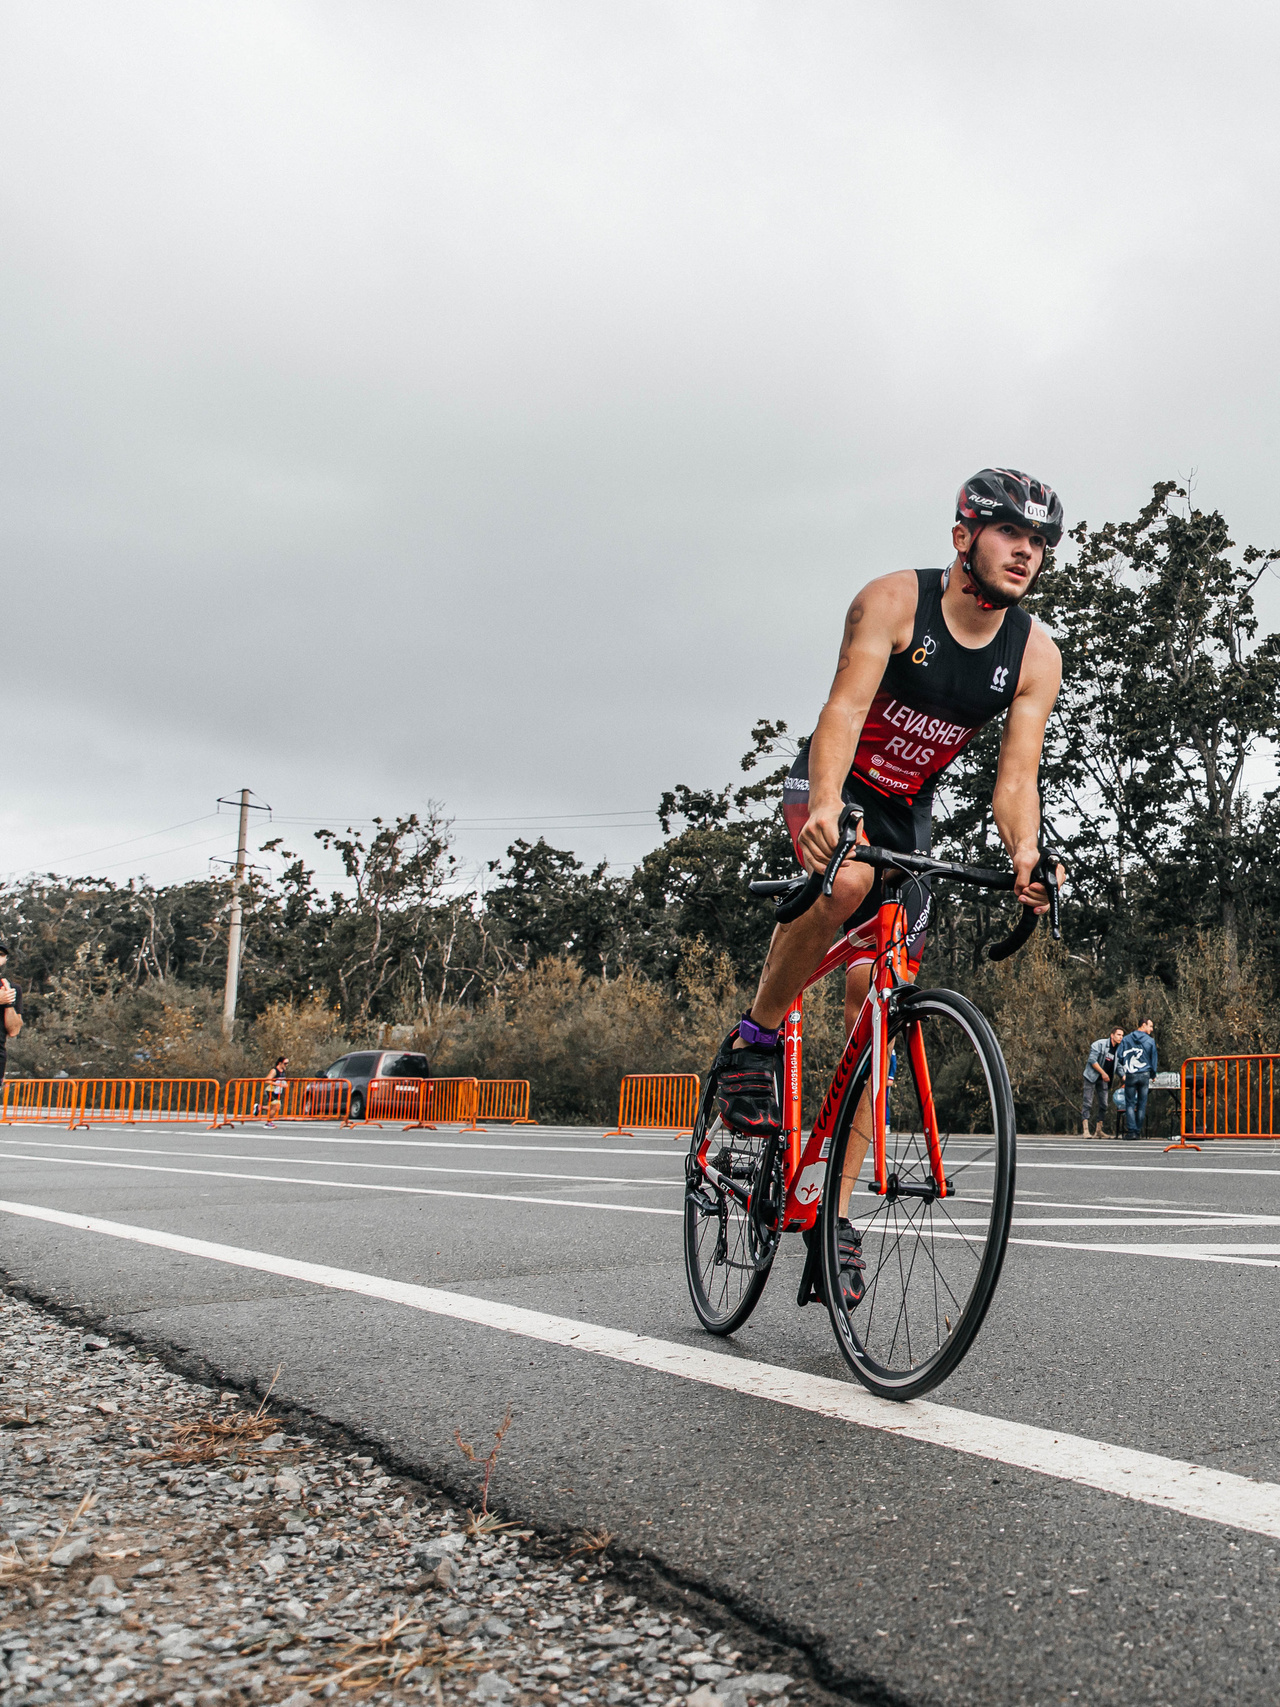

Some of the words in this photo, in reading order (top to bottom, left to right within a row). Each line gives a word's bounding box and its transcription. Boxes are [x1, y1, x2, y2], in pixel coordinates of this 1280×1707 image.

[968, 494, 1003, 507] RUDY
[1027, 505, 1046, 518] 010
[882, 699, 972, 746] LEVASHEV
[884, 735, 935, 766] RUS
